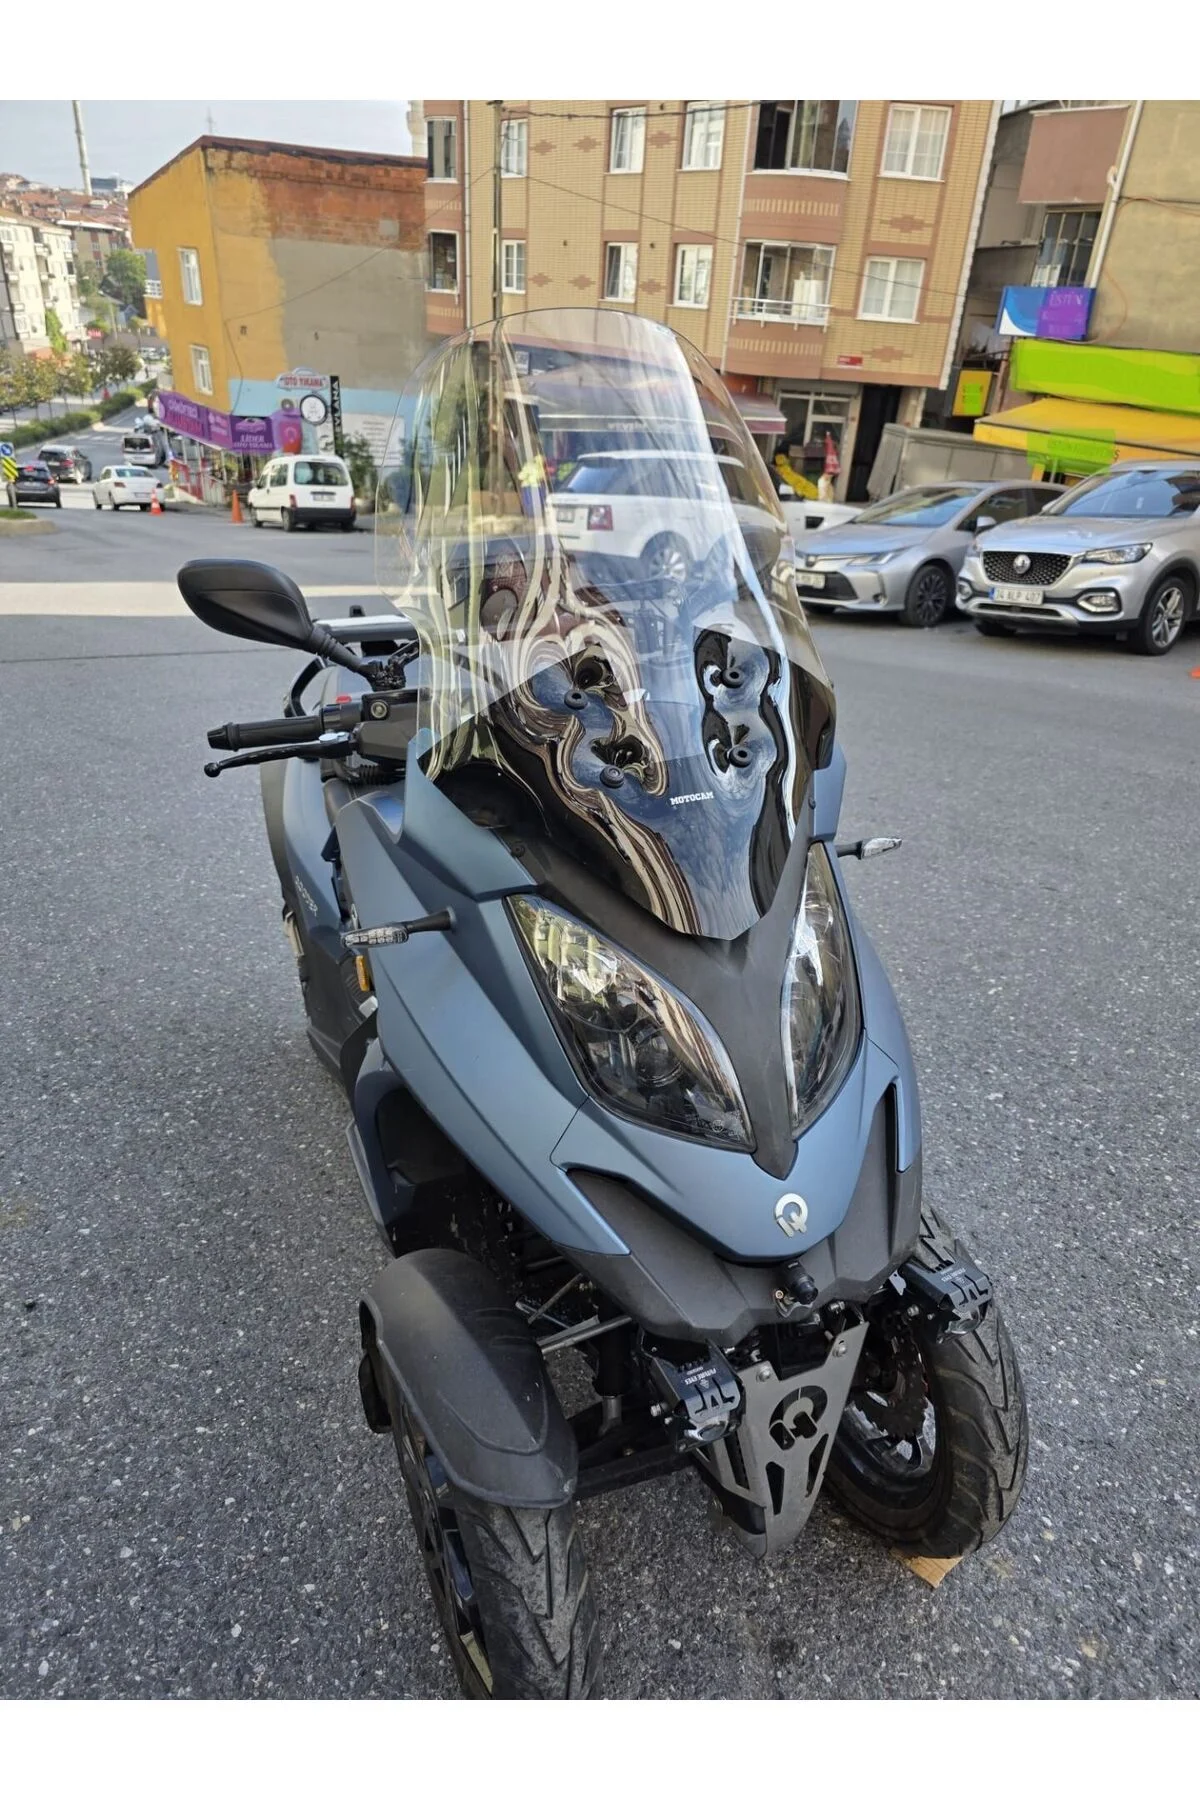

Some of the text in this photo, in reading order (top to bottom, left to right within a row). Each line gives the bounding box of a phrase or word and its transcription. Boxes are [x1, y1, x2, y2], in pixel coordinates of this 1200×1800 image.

[283, 375, 298, 386] OTO
[332, 381, 342, 433] EVLANA
[669, 791, 715, 806] MOTOCAM
